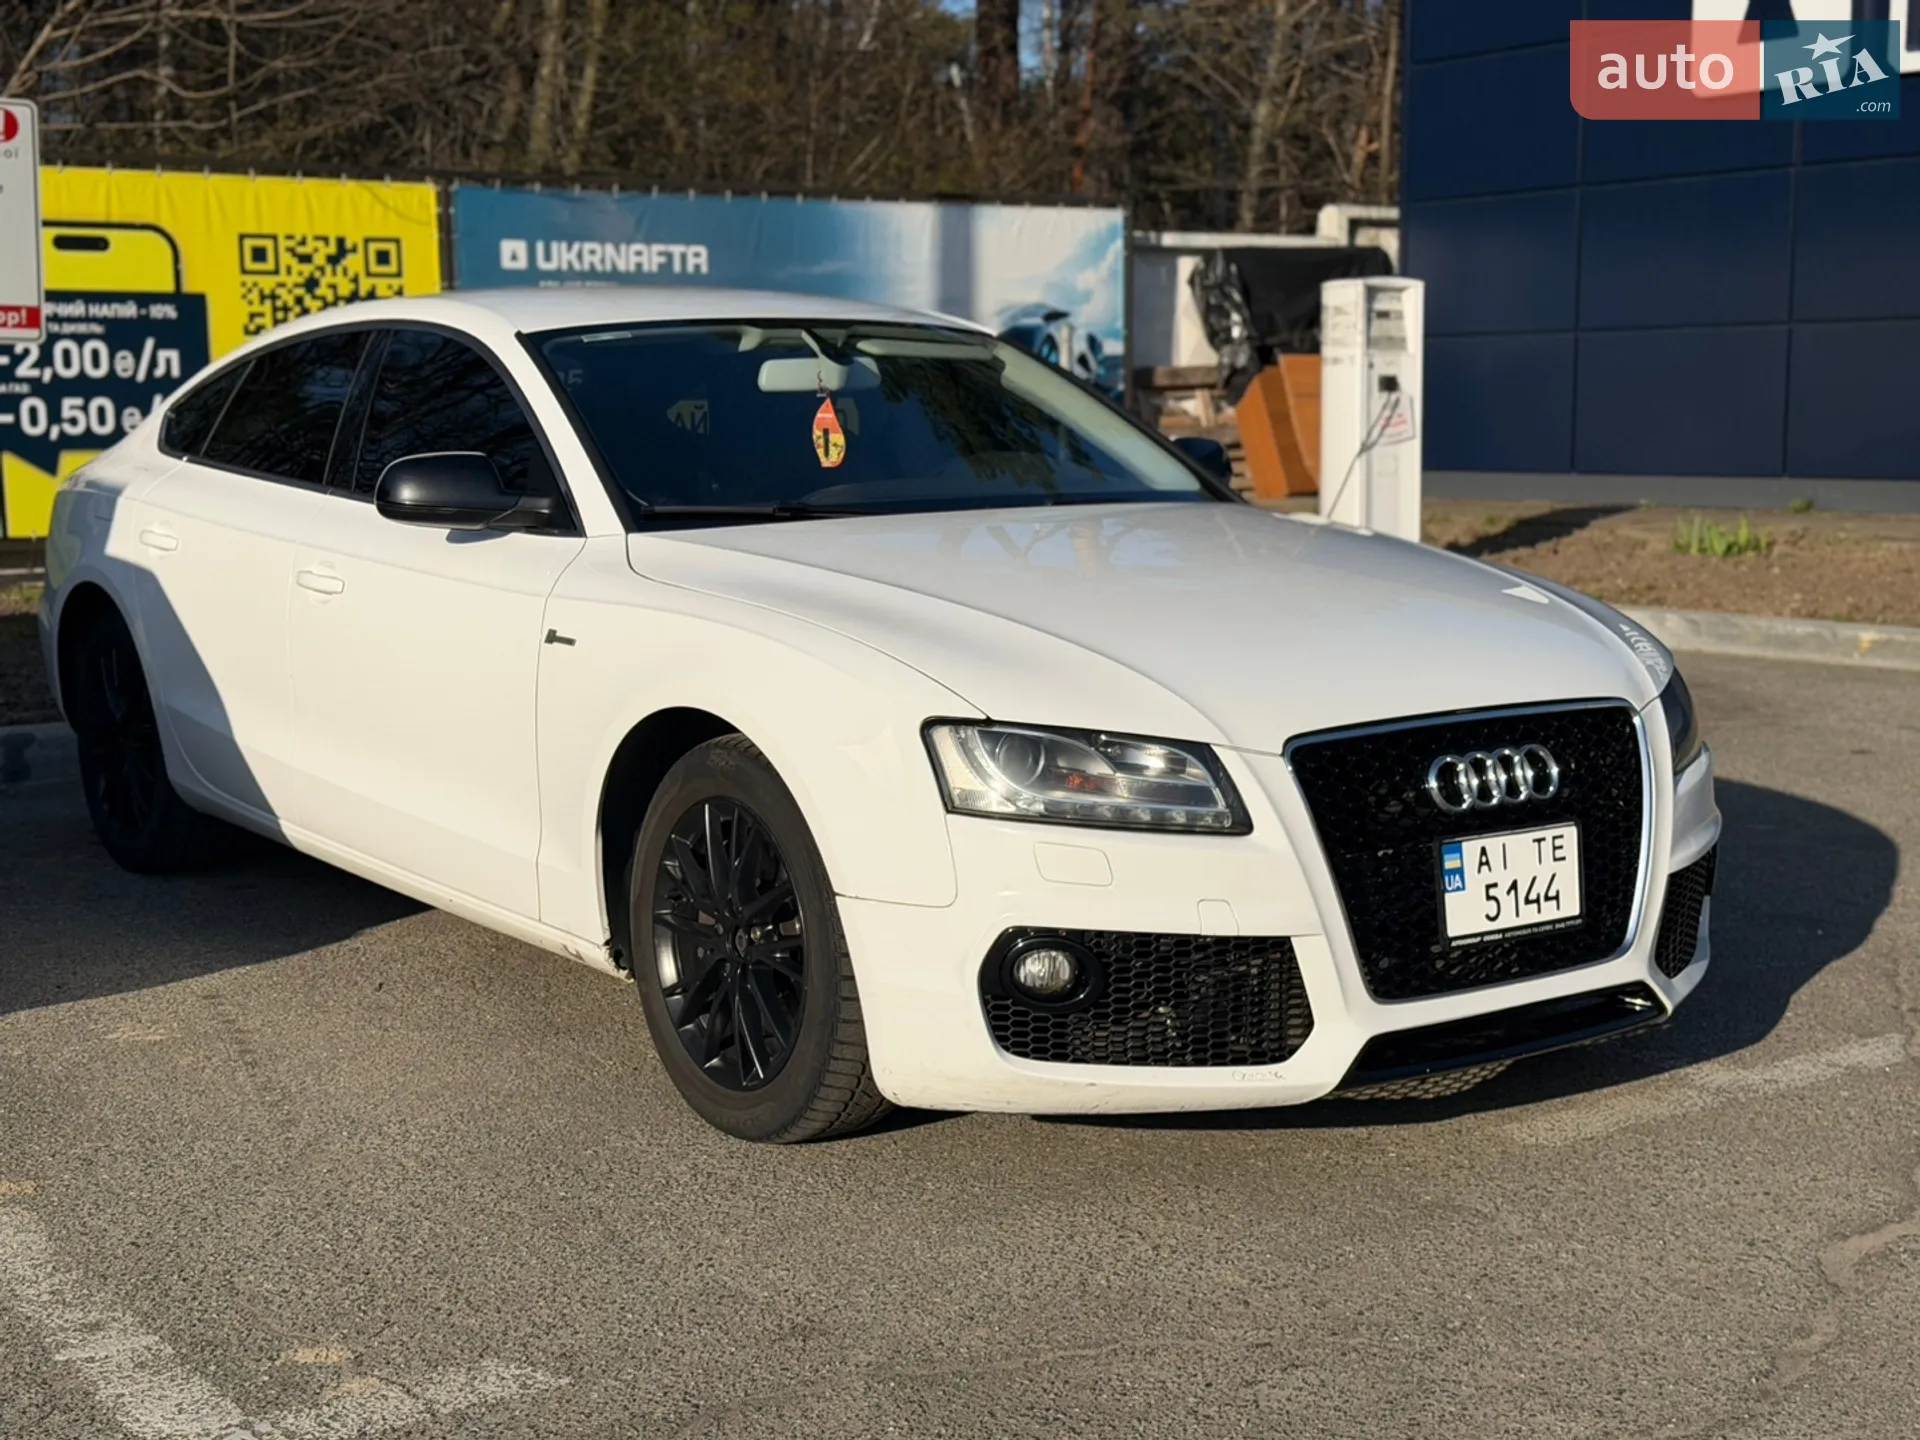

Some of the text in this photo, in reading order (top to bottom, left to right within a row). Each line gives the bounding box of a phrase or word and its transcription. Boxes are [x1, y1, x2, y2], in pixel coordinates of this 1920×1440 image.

[535, 239, 709, 275] UKRNAFTA
[1477, 834, 1567, 874] AI TE
[1444, 874, 1463, 890] UA
[1484, 872, 1561, 922] 5144
